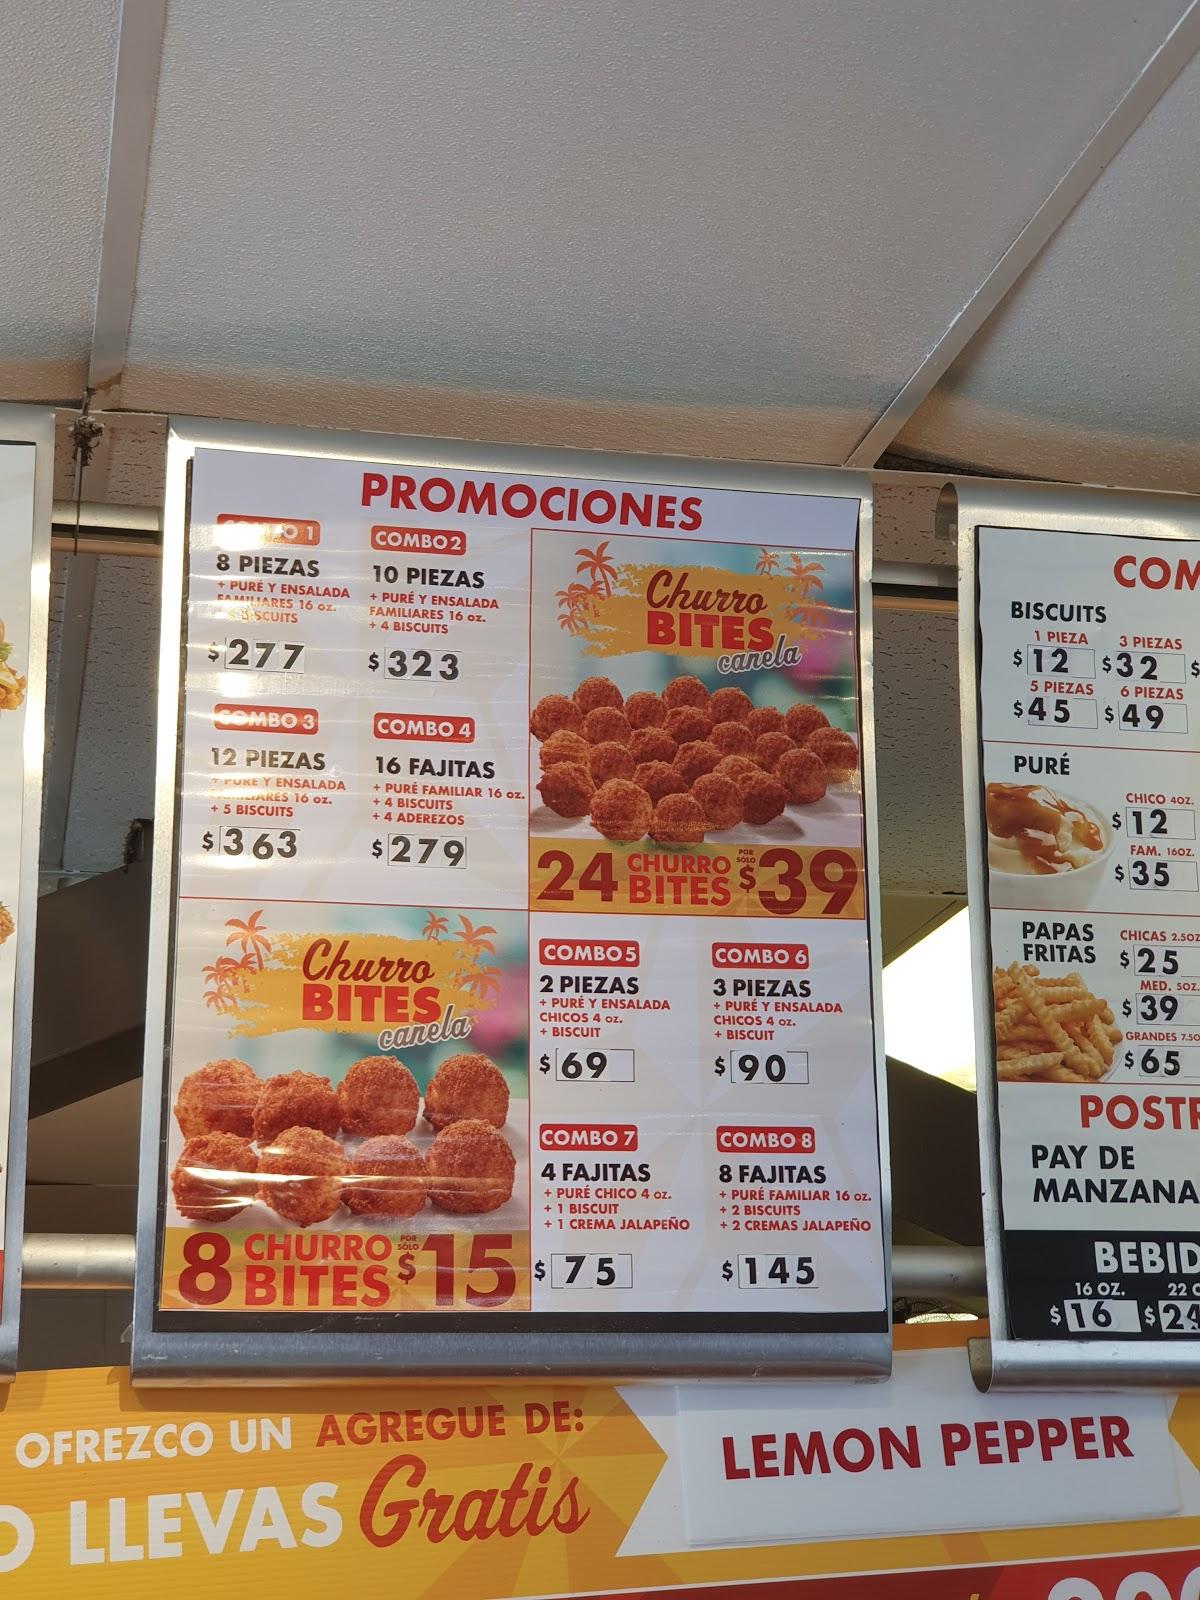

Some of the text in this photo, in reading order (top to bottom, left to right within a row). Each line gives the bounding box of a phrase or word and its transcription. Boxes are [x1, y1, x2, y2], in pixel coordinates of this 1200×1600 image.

[361, 472, 702, 531] PROMOCIONES
[216, 553, 319, 577] 8 PIEZAS
[373, 566, 485, 588] 10 PIEZAS
[230, 579, 350, 598] PURÉ Y ENSALADA
[647, 569, 768, 615] Churro
[300, 600, 337, 611] 16 oz.
[382, 591, 499, 608] PURÉ Y ENSALADA
[369, 606, 486, 622] FAMILIARES 16 oz.
[1011, 601, 1107, 624] BISCUITS
[381, 622, 448, 634] 4 BISCUITS
[647, 611, 774, 652] BITES
[1034, 631, 1088, 644] 1 PIEZA
[1120, 636, 1182, 650] 3 PIEZAS
[717, 634, 801, 674] canela
[1030, 681, 1094, 695] 5 PIEZAS
[1120, 686, 1184, 700] 6 PIEZAS
[302, 714, 314, 729] 3
[377, 719, 471, 737] COMBO 4
[211, 747, 325, 770] 12 PIEZAS
[1014, 752, 1070, 775] PURÉ
[376, 756, 495, 779] 16 FAJITAS
[264, 777, 272, 786] Y
[276, 779, 346, 790] ENSALADA
[385, 782, 525, 799] PURÉ FAMILIAR 16 oz.
[295, 793, 308, 803] 16
[313, 796, 332, 804] oz.
[384, 798, 453, 810] 4 BISCUITS
[1126, 793, 1166, 804] CHICO
[223, 804, 294, 817] 5 BISCUITS
[384, 812, 465, 825] 4 ADEREZOS
[1130, 845, 1161, 856] FAM.
[627, 854, 731, 874] CHURRO
[536, 850, 618, 902] 24
[629, 875, 731, 906] BITES
[1022, 921, 1094, 942] PAPAS
[1120, 930, 1166, 941] CHICAS
[302, 938, 436, 983] Churro
[715, 948, 807, 964] COMBO 6
[1023, 943, 1097, 964] FRITAS
[540, 975, 639, 995] 2 PIEZAS
[713, 979, 811, 998] 3 PIEZAS
[1140, 980, 1171, 991] MED.
[302, 983, 441, 1024] BITES
[551, 996, 671, 1010] PURÉ Y ENSALADA
[725, 999, 843, 1013] PURÉ Y ENSALADA
[540, 1012, 622, 1024] CHICOS 4 oz.
[714, 1015, 796, 1027] CHICOS 4 oz.
[378, 1004, 472, 1051] canela
[552, 1027, 601, 1038] BISCUIT
[726, 1029, 775, 1040] BISCUIT
[1126, 1032, 1177, 1041] GRANDES
[541, 1129, 636, 1147] COMBO 7
[719, 1132, 813, 1148] COMBO 8
[1031, 1145, 1135, 1169] PAY DE
[541, 1163, 651, 1182] 4 FAJITAS
[719, 1165, 826, 1184] 8 FAJITAS
[556, 1184, 672, 1199] PURÉ CHICO 4 oz.
[732, 1186, 872, 1201] PURÉ FAMILIAR 16 oz.
[1033, 1178, 1200, 1204] MANZANA
[558, 1203, 620, 1214] 1 BISCUIT
[732, 1205, 801, 1216] 2 BISCUITS
[558, 1216, 690, 1231] 1 CREMA JALAPEÑO
[732, 1217, 872, 1232] 2 CREMAS JALAPEÑO
[244, 1232, 392, 1262] CHURRO
[177, 1231, 232, 1307] 8
[244, 1265, 391, 1307] BITES
[1075, 1282, 1125, 1296] 16 OZ.
[1168, 1283, 1187, 1296] 22
[15, 1400, 585, 1469] OFREZCO UN AGREGUE DE:
[721, 1415, 1135, 1481] LEMON PEPPER
[68, 1453, 591, 1566] LLEVAS Gratis
